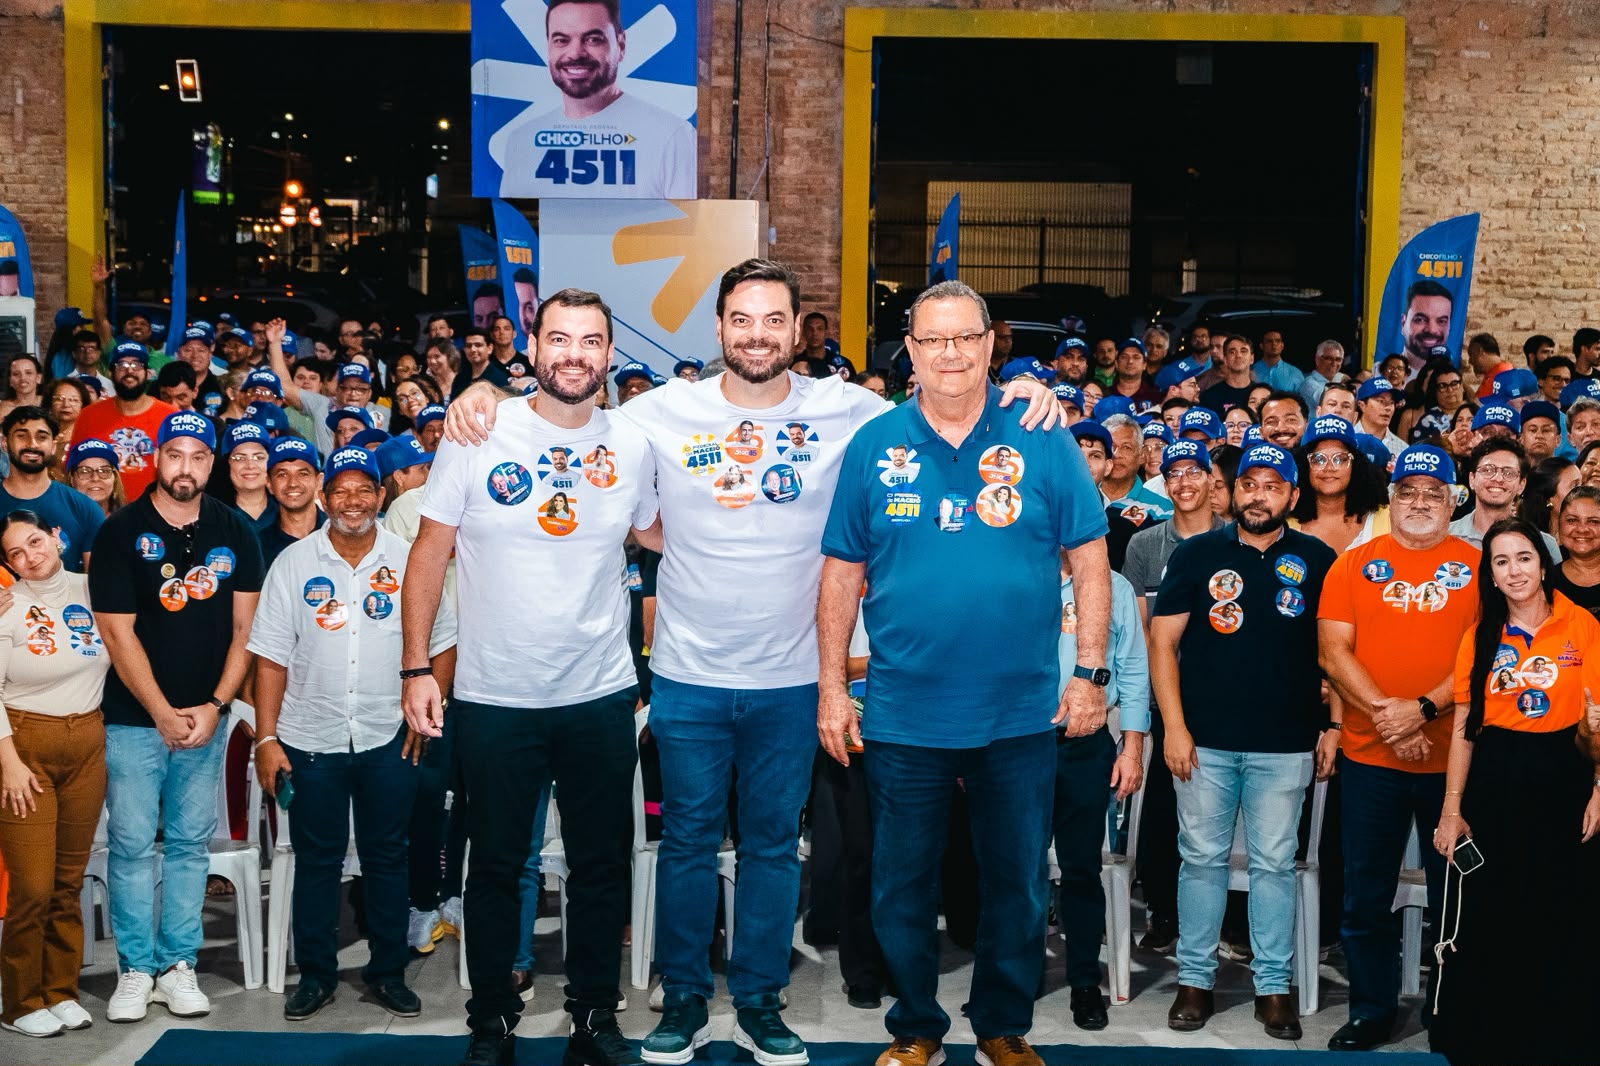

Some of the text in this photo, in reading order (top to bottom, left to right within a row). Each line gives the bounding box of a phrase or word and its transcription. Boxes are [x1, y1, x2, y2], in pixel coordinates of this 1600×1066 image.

[535, 149, 636, 185] 4511
[1417, 260, 1463, 278] 4511
[117, 342, 141, 351] CHICO
[252, 372, 276, 382] CHICO
[421, 406, 445, 416] CHICO
[1185, 411, 1212, 421] CHICO
[1486, 407, 1513, 417] CHICO
[171, 414, 207, 428] CHICO
[1314, 418, 1347, 429] CHICO
[171, 424, 195, 432] FILHO
[232, 424, 261, 435] CHICO
[78, 441, 108, 452] CHICO
[275, 441, 307, 452] CHICO
[1167, 441, 1198, 454] CHICO
[333, 449, 368, 463] CHICO
[791, 454, 811, 462] 4511
[1168, 450, 1188, 459] FILHO
[1249, 446, 1285, 460] CHICO
[1404, 452, 1440, 464] CHICO
[687, 451, 722, 468] 4511
[1404, 463, 1427, 471] FILHO
[552, 480, 572, 488] 4511
[889, 476, 908, 484] 4511
[885, 503, 920, 517] 4511
[1277, 565, 1303, 584] 4511
